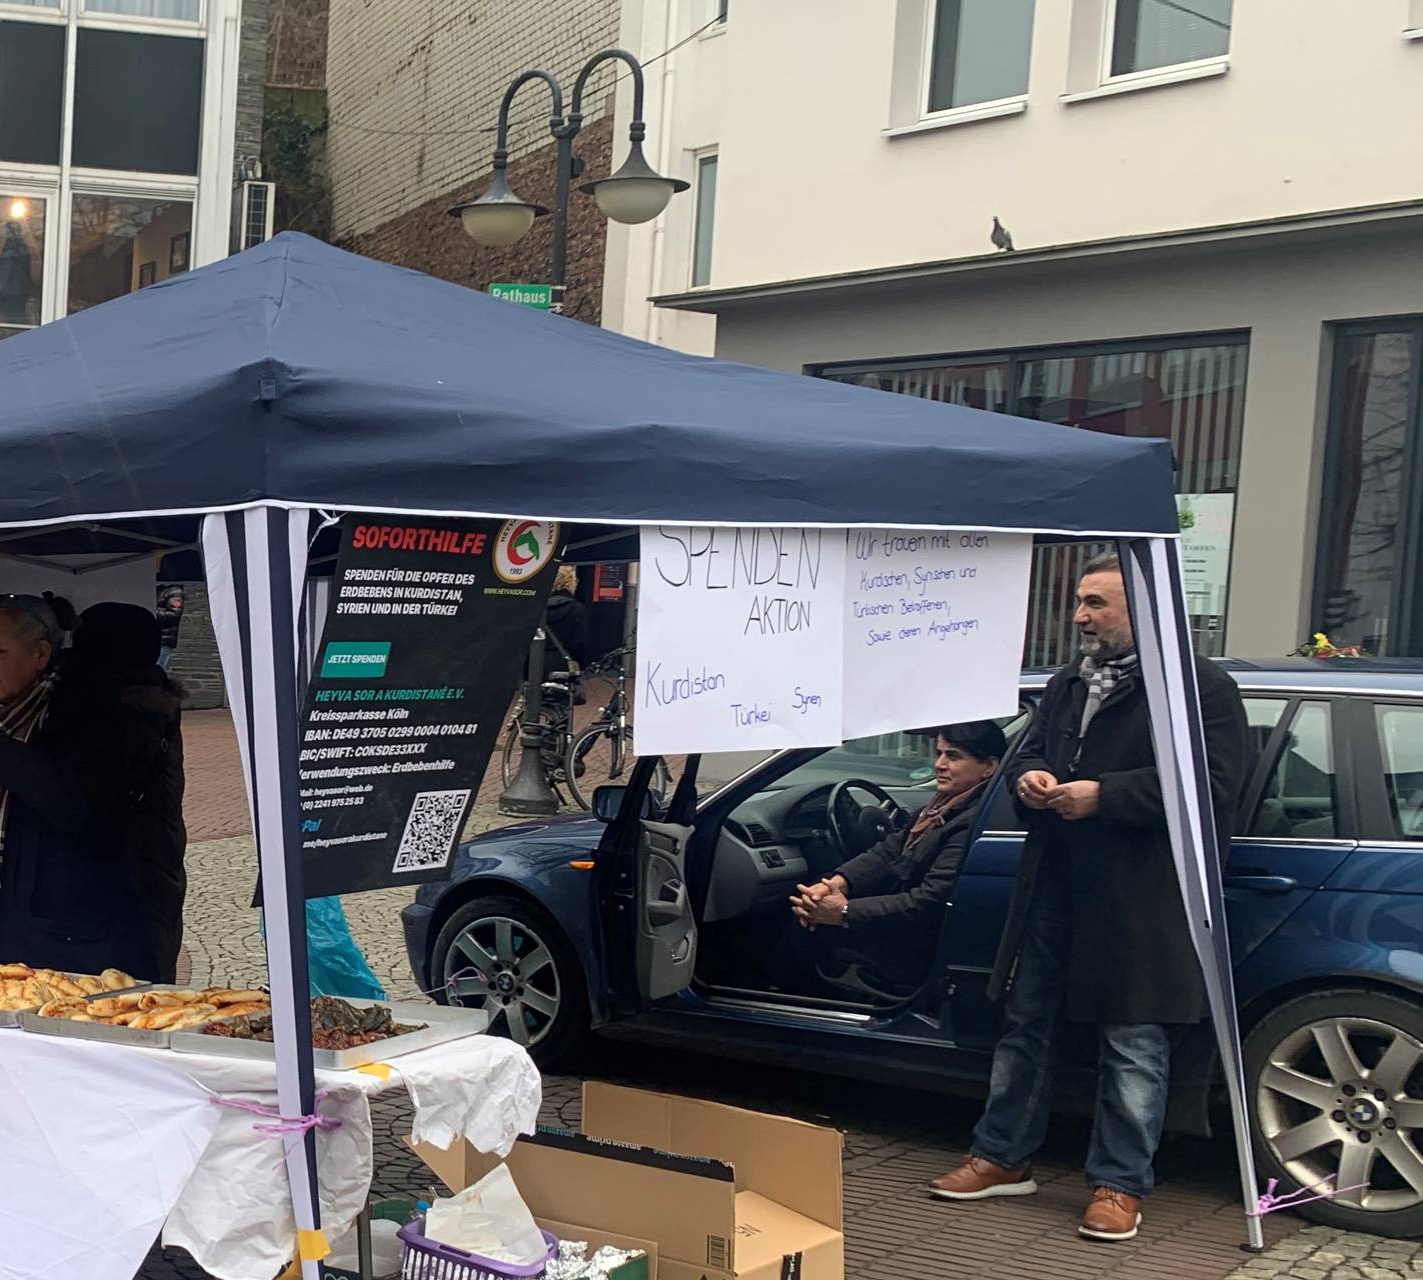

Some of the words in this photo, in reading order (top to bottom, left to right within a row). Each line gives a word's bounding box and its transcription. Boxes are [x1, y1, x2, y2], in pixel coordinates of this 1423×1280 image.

[352, 525, 487, 555] SOFORTHILFE
[654, 526, 822, 590] SPENDEN
[343, 568, 386, 581] SPENDEN
[386, 567, 404, 581] FÜR
[404, 570, 422, 582] DIE
[422, 571, 456, 584] OPFER
[455, 573, 475, 585] DES
[340, 586, 393, 598] ERDBEBENS
[393, 587, 404, 598] IN
[404, 587, 463, 603] KURDISTAN,
[336, 602, 371, 615] SYRIEN
[370, 603, 391, 615] UND
[391, 603, 403, 615] IN
[402, 603, 422, 615] DER
[422, 601, 458, 616] TÜRKEI
[744, 595, 811, 635] AKTION
[328, 654, 351, 664] JETZT
[352, 654, 386, 664] SPENDEN
[645, 661, 726, 708] Kurdistan
[315, 690, 352, 701] HEYVA
[353, 690, 375, 701] SOR
[375, 690, 384, 701] A
[447, 688, 465, 699] E.V.
[309, 709, 387, 723] Kreissparkasse
[386, 707, 409, 720] Köln
[304, 729, 332, 742] IBAN:
[332, 728, 360, 740] DE49
[361, 727, 387, 738] 3705
[388, 726, 413, 738] 0299
[414, 725, 440, 736] 0004
[440, 724, 464, 735] 0104
[464, 723, 478, 734] 81
[299, 746, 354, 761] BIC/SWIFT:
[354, 743, 428, 757] COKSDE33XXX
[391, 759, 456, 773] Erdbebenhilfe
